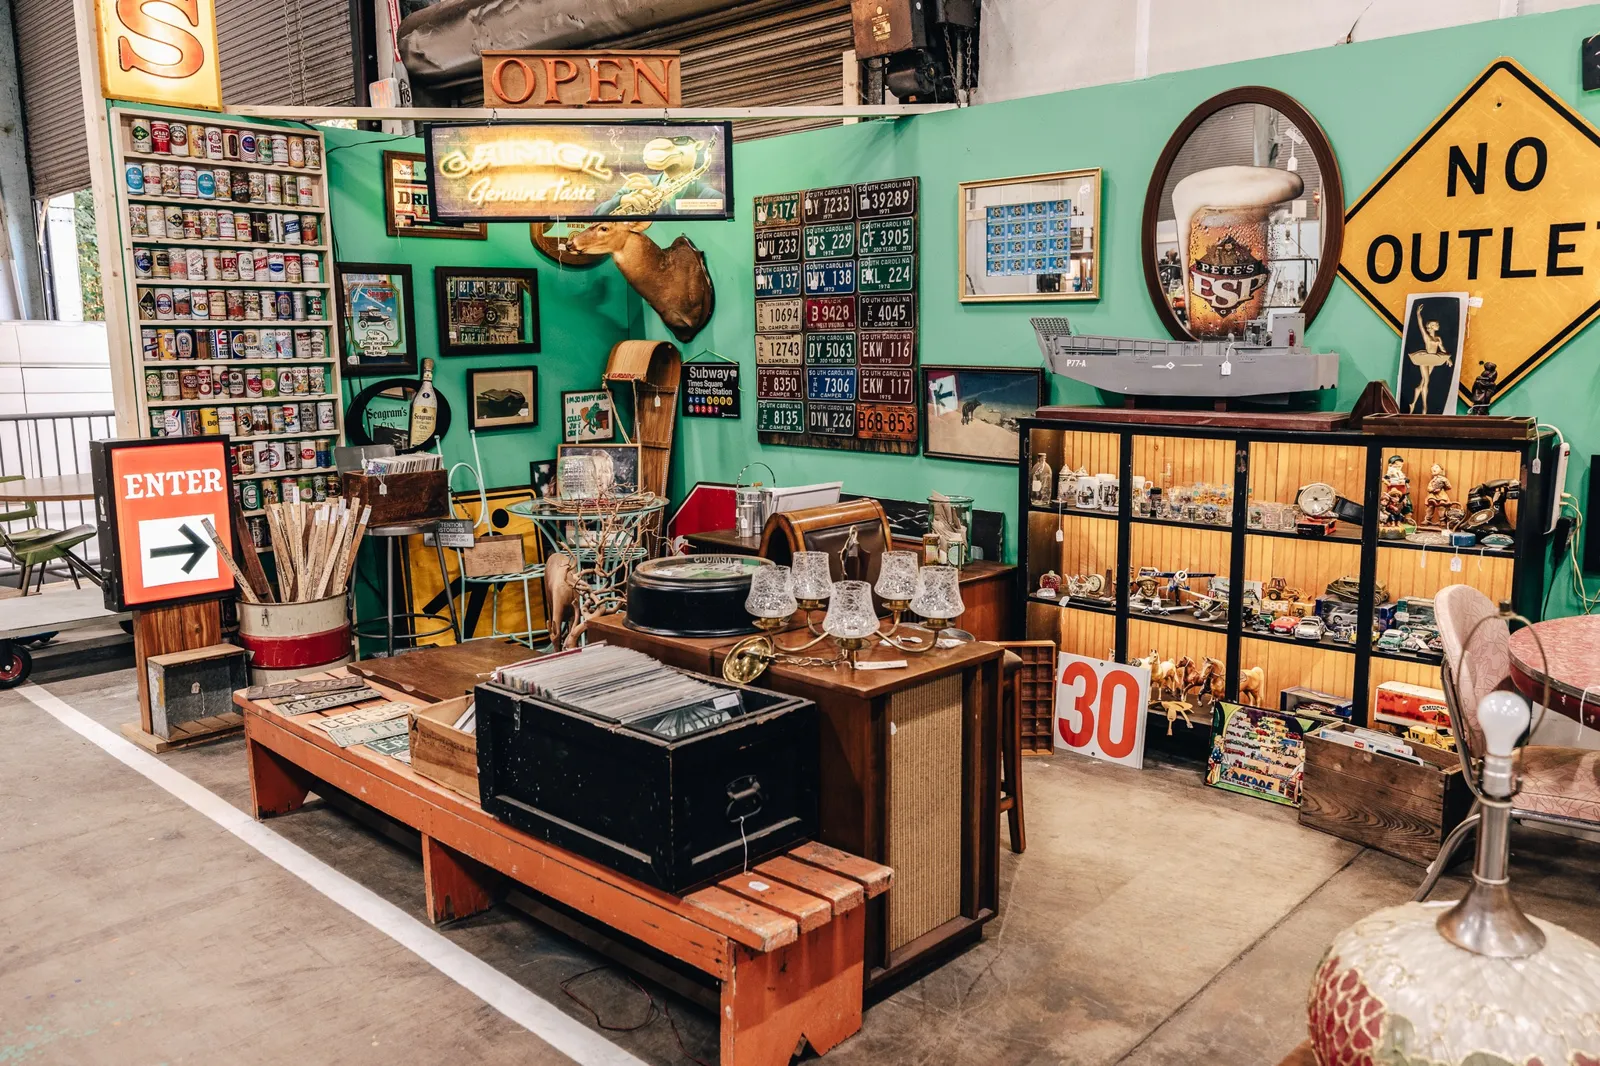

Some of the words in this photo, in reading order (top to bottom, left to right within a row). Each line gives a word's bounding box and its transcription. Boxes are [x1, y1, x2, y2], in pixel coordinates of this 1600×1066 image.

[491, 58, 673, 104] OPEN
[1447, 137, 1548, 196] NO
[468, 178, 548, 205] Genuine
[549, 176, 596, 201] Taste
[824, 196, 849, 213] 7233
[872, 190, 909, 209] 39289
[773, 202, 797, 218] 5174
[832, 232, 852, 249] 229
[880, 228, 909, 245] 3905
[779, 238, 796, 254] 233
[1366, 221, 1600, 284] OUTLE
[888, 265, 910, 282] 224
[1201, 263, 1254, 274] PETE'S
[780, 272, 798, 289] 137
[833, 269, 851, 286] 138
[1192, 271, 1268, 308] ESP
[770, 307, 798, 323] 10694
[812, 306, 818, 322] B
[822, 305, 849, 321] 9428
[878, 303, 906, 321] 4045
[771, 342, 799, 356] 12743
[809, 343, 822, 358] DY
[826, 342, 852, 358] 5063
[862, 342, 882, 357] EKW
[891, 342, 909, 357] 116
[689, 366, 729, 381] Subway
[704, 380, 723, 388] Square
[774, 377, 796, 391] 8350
[825, 378, 849, 392] 7306
[862, 378, 882, 394] EKW
[891, 378, 909, 394] 117
[368, 406, 408, 420] Seagram's
[414, 413, 435, 421] Seagram's
[774, 411, 798, 425] 8135
[811, 412, 828, 427] DYN
[833, 413, 851, 428] 226
[858, 412, 914, 432] B68-853
[123, 468, 223, 500] ENTER
[1263, 601, 1288, 612] 580E
[1058, 661, 1140, 759] 30
[1231, 770, 1274, 790] ARCADE
